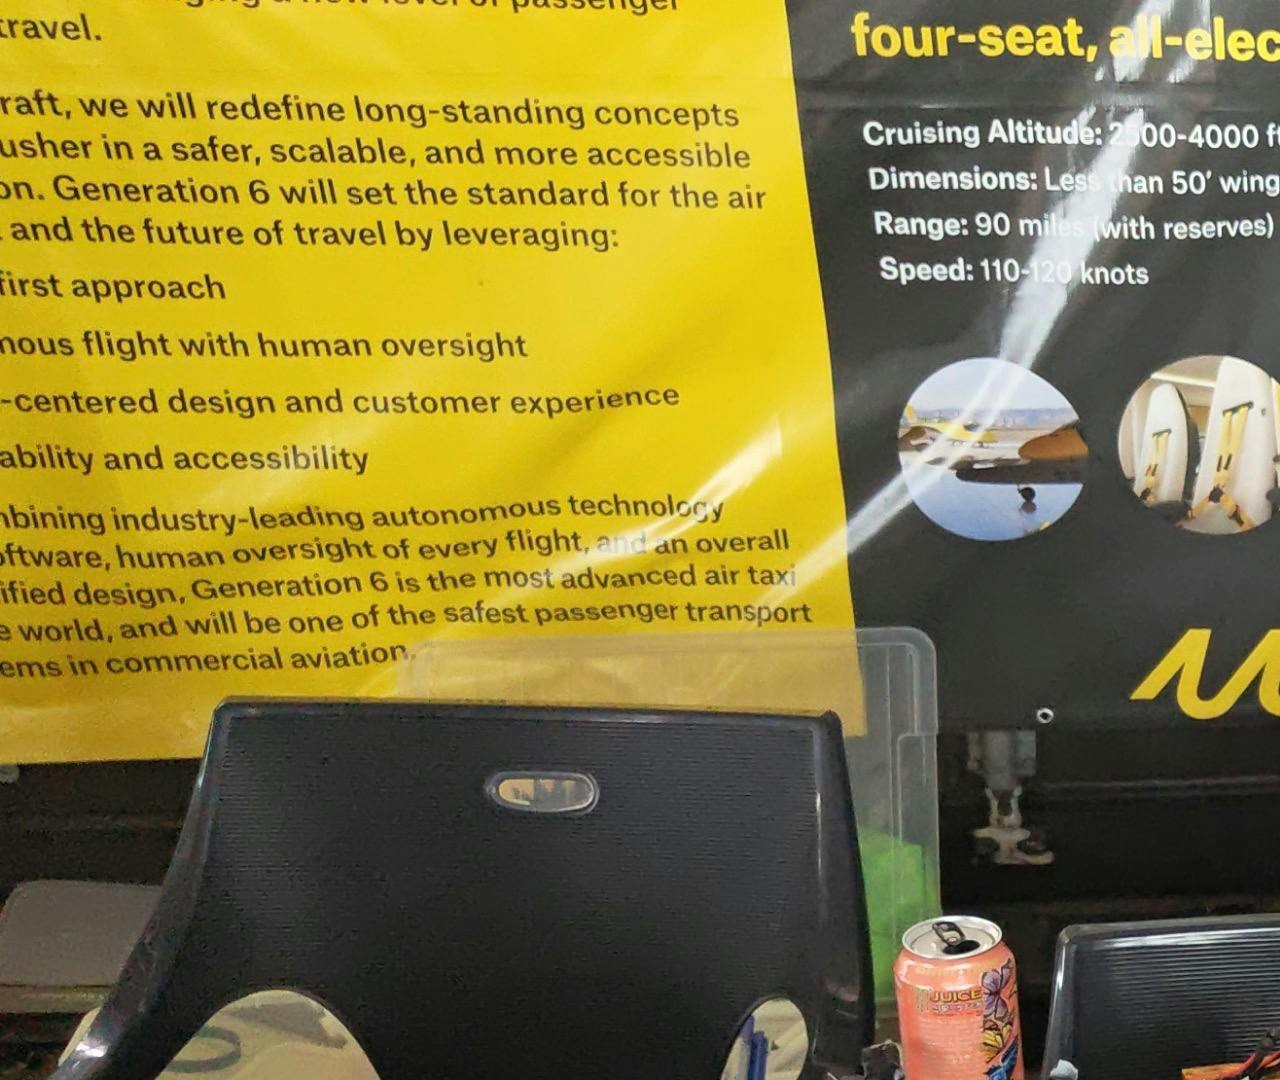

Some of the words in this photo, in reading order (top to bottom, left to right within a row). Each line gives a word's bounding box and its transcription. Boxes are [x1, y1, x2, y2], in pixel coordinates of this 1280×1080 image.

[851, 13, 1097, 62] four-seat,
[0, 88, 71, 120] raft,
[77, 97, 129, 118] we
[136, 91, 197, 119] will
[206, 93, 345, 122] redefine
[354, 95, 585, 131] long-standing
[595, 104, 739, 132] concepts
[0, 131, 93, 159] usher
[101, 133, 134, 160] in
[143, 142, 163, 162] a
[171, 135, 261, 166] safer,
[270, 136, 415, 168] scalable,
[425, 138, 485, 165] and
[494, 146, 578, 166] more
[587, 141, 751, 168] accessible
[863, 119, 980, 148] Cruising
[988, 117, 1103, 147] Altitude:
[52, 174, 240, 204] Generation
[249, 179, 270, 205] 6
[279, 178, 337, 205] will
[347, 182, 397, 206] set
[404, 179, 458, 206] the
[467, 179, 609, 206] standard
[617, 181, 660, 207] for
[669, 182, 718, 209] the
[728, 184, 766, 210] air
[868, 165, 1038, 191] Dimensions:
[1044, 167, 1100, 191] Less
[1107, 170, 1164, 194] than
[10, 216, 74, 243] and
[80, 216, 135, 243] the
[142, 217, 244, 246] future
[253, 219, 284, 246] of
[293, 220, 387, 247] travel
[395, 220, 433, 252] by
[442, 220, 619, 253] leveraging:
[873, 211, 968, 241] Range:
[975, 213, 1011, 237] 90
[1018, 214, 1084, 238] miles
[1094, 215, 1155, 241] (with
[1163, 212, 1274, 240] reserves)
[71, 273, 226, 304] approach
[879, 256, 974, 285] Speed:
[979, 257, 1073, 284] 110-120
[1080, 261, 1150, 286] knots
[81, 330, 173, 362] flight
[178, 331, 250, 357] with
[257, 331, 372, 357] human
[381, 332, 528, 363] oversight
[0, 388, 159, 414] -centered
[168, 387, 276, 419] design
[285, 387, 343, 413] and
[353, 391, 501, 414] customer
[511, 388, 679, 419] experience
[0, 443, 93, 476] ability
[104, 444, 164, 471] and
[174, 444, 368, 476] accessibility
[111, 505, 365, 536] industry-leading
[372, 499, 561, 527] autonomous
[568, 492, 725, 523] technology
[115, 543, 225, 569] human
[232, 537, 377, 563] oversight
[382, 538, 410, 560] of
[418, 538, 498, 560] every
[506, 531, 591, 554] flight,
[655, 537, 688, 555] an
[695, 528, 790, 554] overall
[74, 581, 186, 609] design,
[191, 573, 362, 600] Generation
[369, 571, 389, 592] 6
[395, 571, 421, 593] is
[426, 570, 476, 592] the
[484, 568, 555, 589] most
[561, 563, 697, 589] advanced
[705, 563, 739, 586] air
[748, 563, 796, 587] taxi
[17, 618, 113, 643] world,
[119, 614, 178, 639] and
[184, 610, 238, 635] will
[243, 610, 281, 634] be
[289, 615, 343, 634] one
[352, 604, 380, 629] of
[386, 603, 436, 626] the
[443, 600, 529, 624] safest
[534, 603, 679, 626] passenger
[687, 603, 813, 628] transport
[0, 661, 64, 678] ems
[67, 655, 99, 676] in
[105, 646, 283, 674] commercial
[290, 642, 416, 669] aviation.
[929, 988, 982, 1003] JUICE
